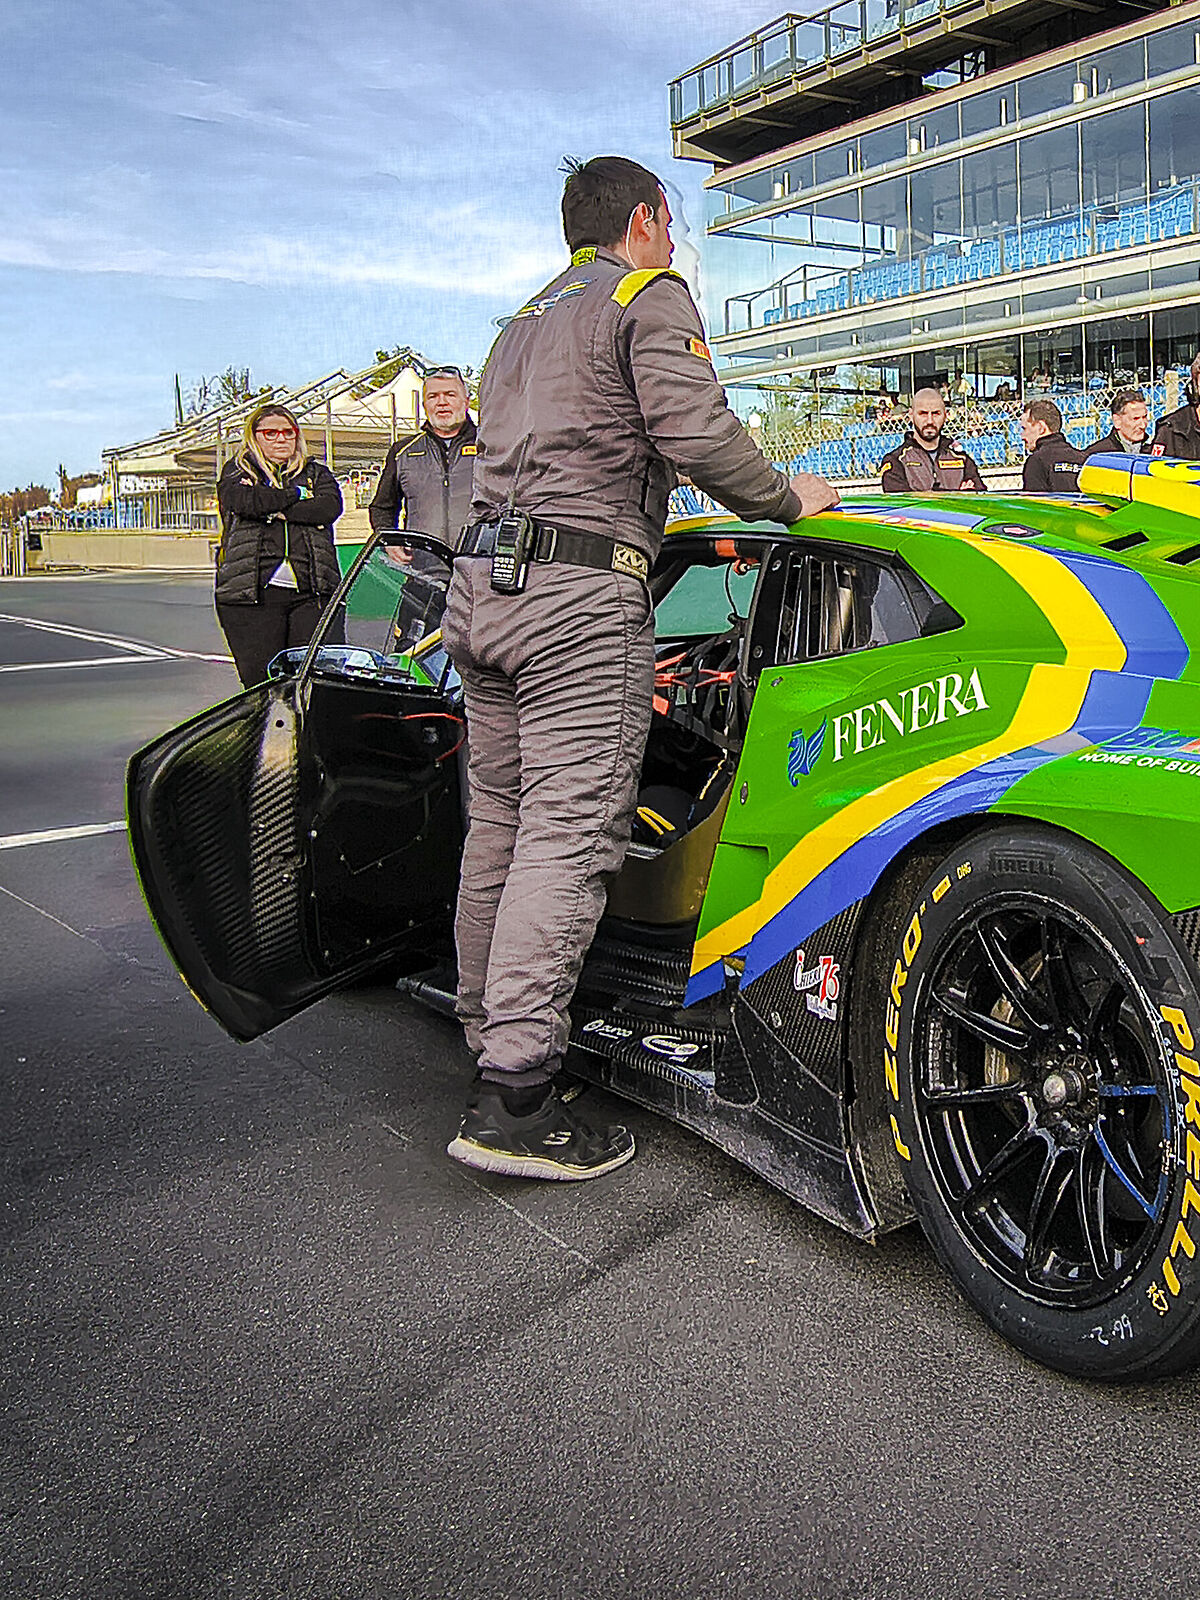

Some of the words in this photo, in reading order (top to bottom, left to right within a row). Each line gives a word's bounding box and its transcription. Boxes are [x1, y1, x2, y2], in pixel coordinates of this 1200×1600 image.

[832, 667, 990, 762] FENERA
[1077, 752, 1138, 766] HOME
[1136, 757, 1168, 769] OF
[884, 912, 922, 1101] ZERO
